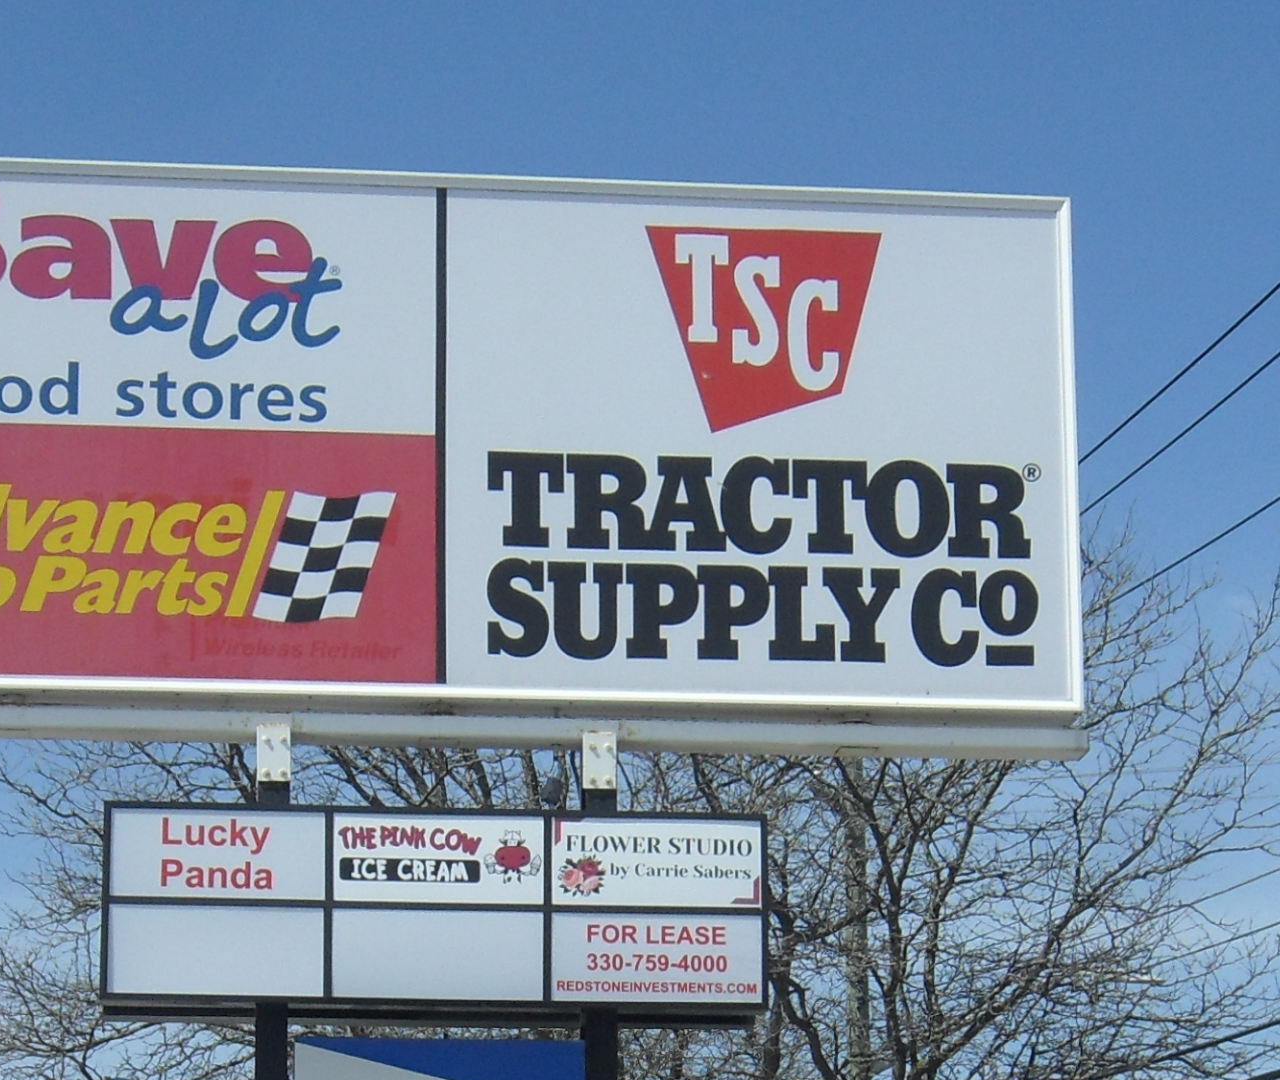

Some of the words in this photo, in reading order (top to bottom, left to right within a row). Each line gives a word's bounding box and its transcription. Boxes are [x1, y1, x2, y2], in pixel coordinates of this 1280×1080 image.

[675, 233, 840, 392] TSC
[115, 371, 328, 423] stores
[486, 450, 1032, 559] TRACTOR
[20, 555, 230, 617] Parts
[486, 556, 901, 663] SUPPLY
[161, 817, 271, 855] Lucky
[338, 826, 377, 849] THE
[380, 825, 426, 849] PINK
[429, 827, 483, 855] COW
[565, 834, 662, 853] FLOWER
[668, 836, 753, 857] STUDIO
[160, 858, 273, 890] Panda
[350, 858, 388, 881] ICE
[397, 859, 469, 882] CREAM
[610, 862, 630, 880] by
[634, 863, 689, 879] Carrie
[693, 864, 752, 880] Sabers
[586, 924, 638, 944] FOR
[646, 925, 727, 946] LEASE
[586, 953, 728, 973] 330-759-4000
[556, 980, 758, 994] REDSTONEINVESTMENTS.COM
